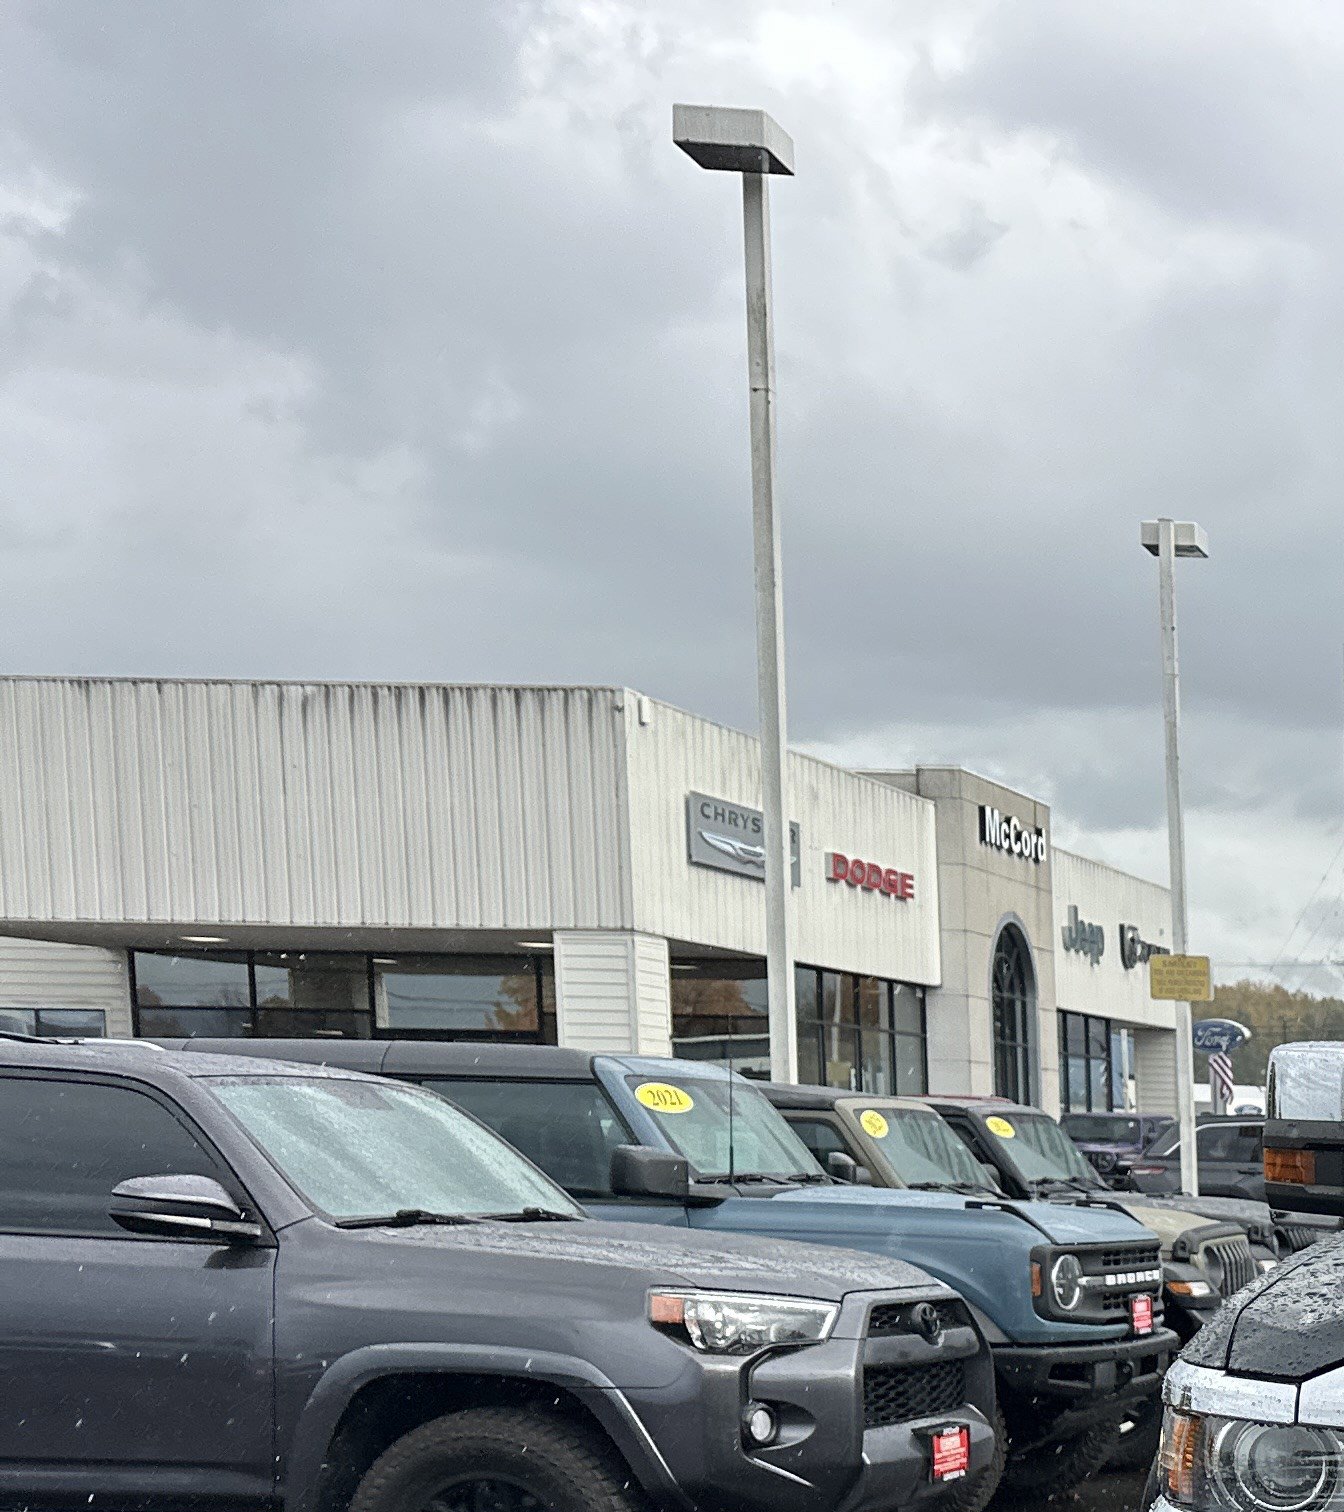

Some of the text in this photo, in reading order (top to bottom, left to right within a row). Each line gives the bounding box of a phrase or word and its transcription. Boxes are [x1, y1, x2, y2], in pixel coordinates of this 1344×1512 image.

[983, 805, 1047, 862] McCord
[831, 852, 915, 899] DODGE
[646, 1090, 683, 1106] 2021
